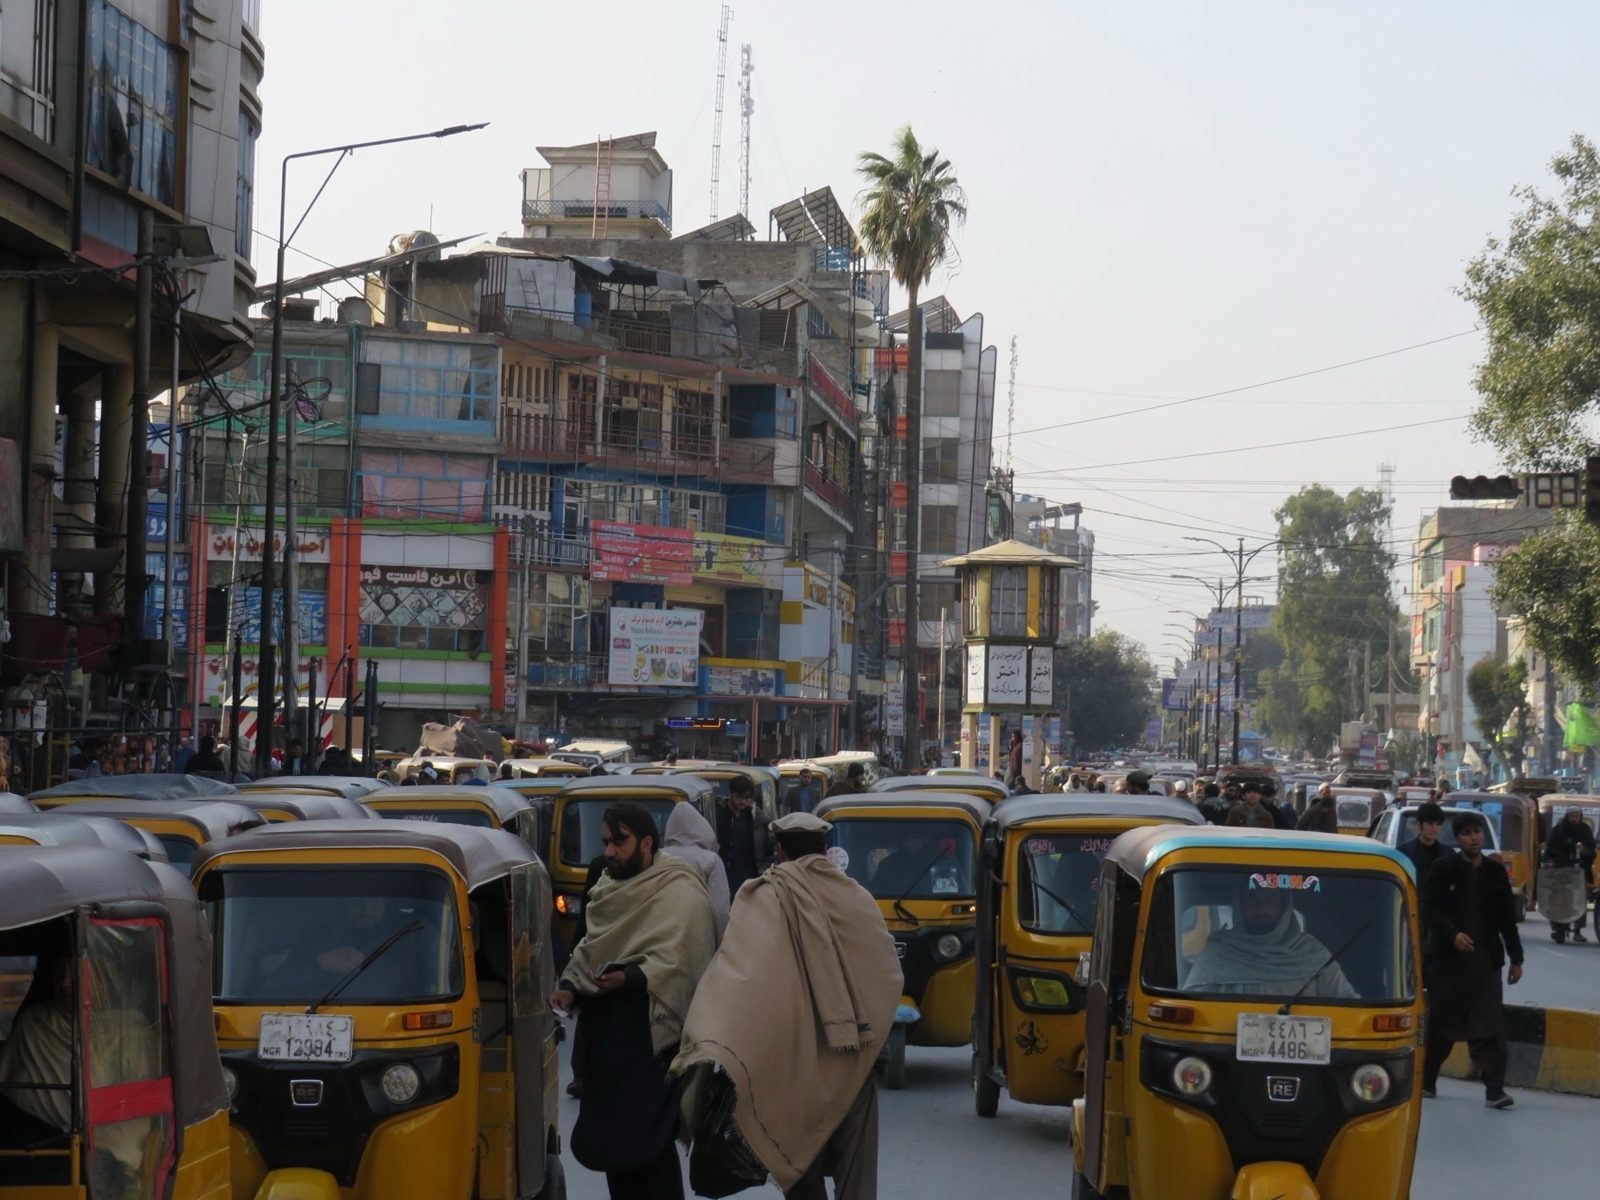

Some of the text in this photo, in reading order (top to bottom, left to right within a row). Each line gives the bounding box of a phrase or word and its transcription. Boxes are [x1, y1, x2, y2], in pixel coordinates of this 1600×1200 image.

[430, 570, 461, 587] امن
[995, 665, 1020, 680] اختر
[1032, 665, 1051, 680] اختر
[262, 1046, 281, 1056] NGR
[1240, 1047, 1259, 1057] NGR
[1267, 1040, 1307, 1060] 4486
[1272, 1084, 1294, 1096] RE
